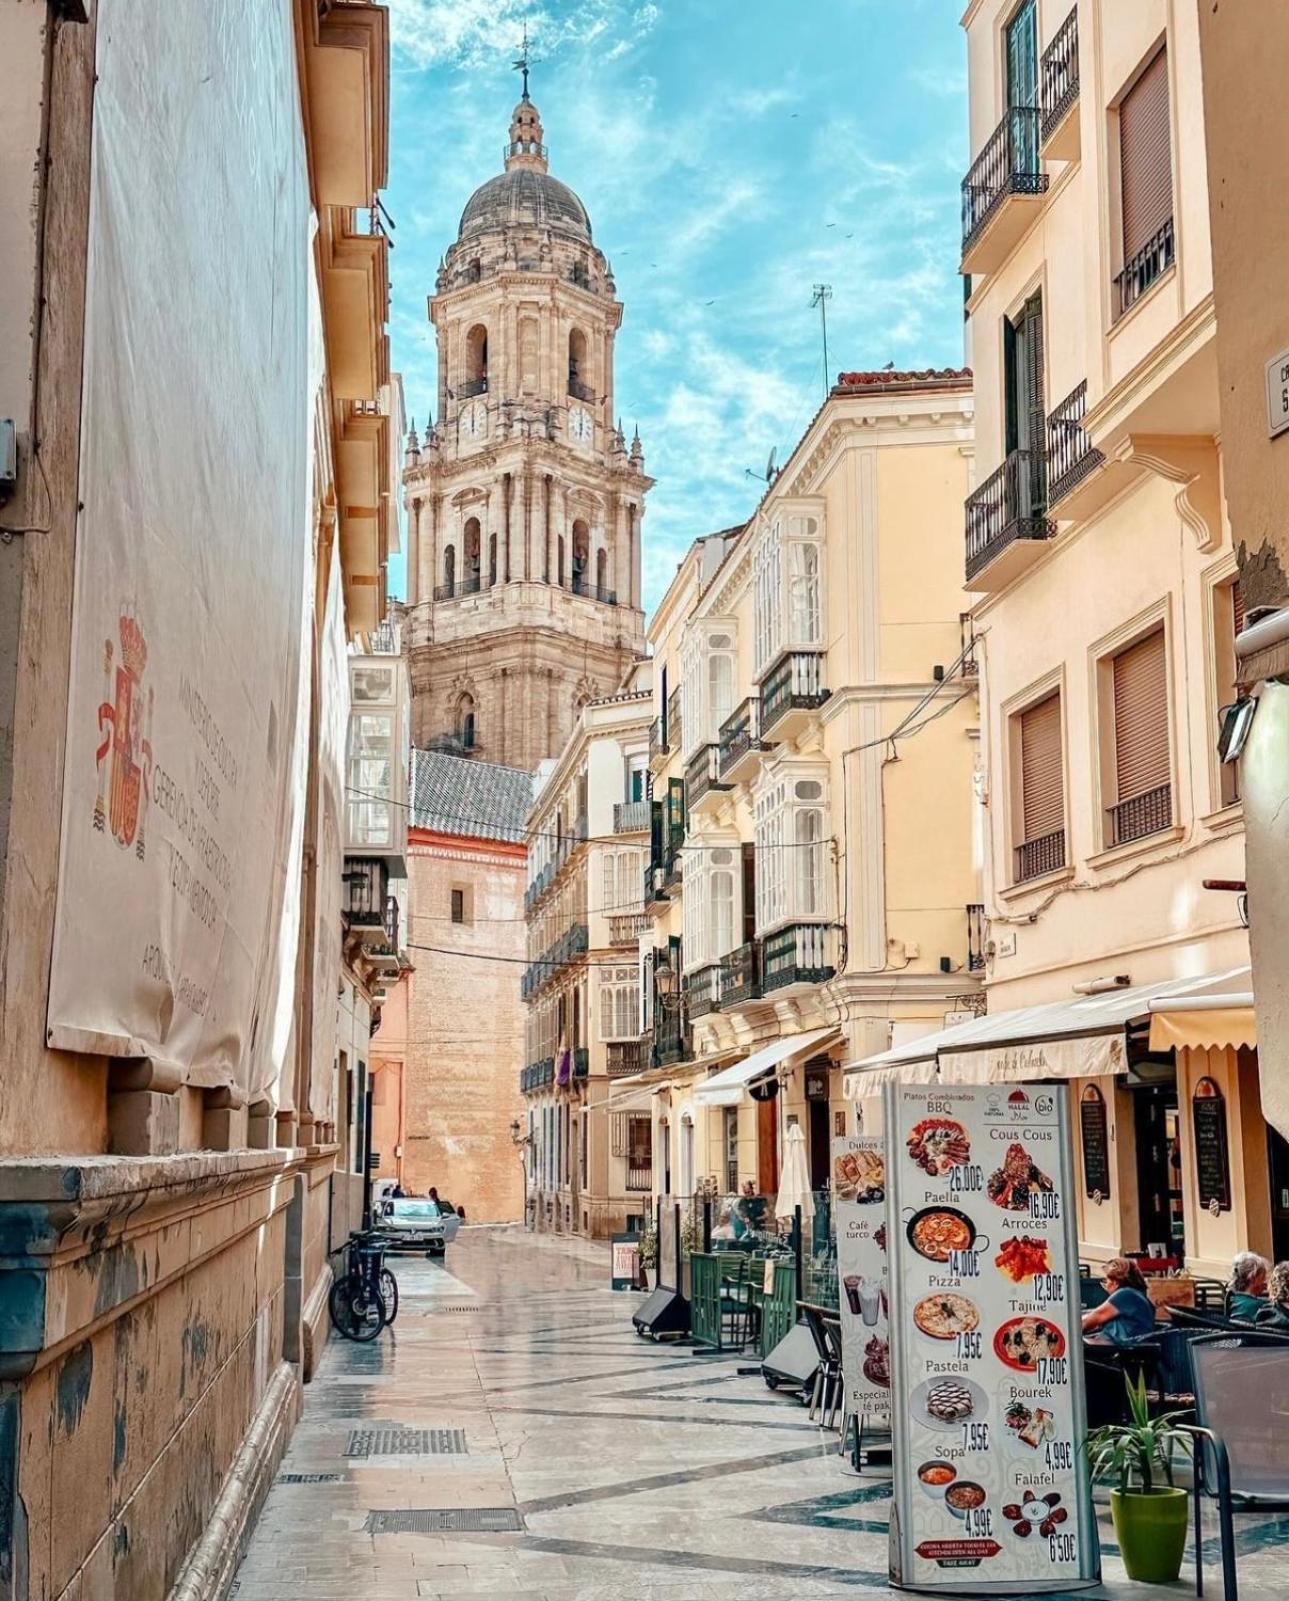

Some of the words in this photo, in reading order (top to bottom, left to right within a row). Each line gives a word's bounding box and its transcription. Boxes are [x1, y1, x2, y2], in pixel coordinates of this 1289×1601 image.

[904, 1092, 927, 1101] Platos
[928, 1092, 975, 1101] Combinados
[927, 1101, 953, 1115] BBQ
[1038, 1099, 1053, 1112] bio
[990, 1129, 1019, 1140] Cous
[1022, 1129, 1052, 1140] Cous
[849, 1141, 877, 1150] Dulces
[924, 1191, 960, 1203] Paella
[849, 1220, 869, 1230] Café
[1002, 1217, 1048, 1229] Arroces
[846, 1231, 869, 1239] turco
[929, 1275, 960, 1287] Pizza
[1008, 1299, 1047, 1314] Tajine
[925, 1360, 969, 1372] Pastela
[853, 1391, 889, 1402] Especial
[1010, 1386, 1052, 1398] Bourek
[935, 1446, 965, 1460] Sopa
[1015, 1473, 1054, 1485] Falafel
